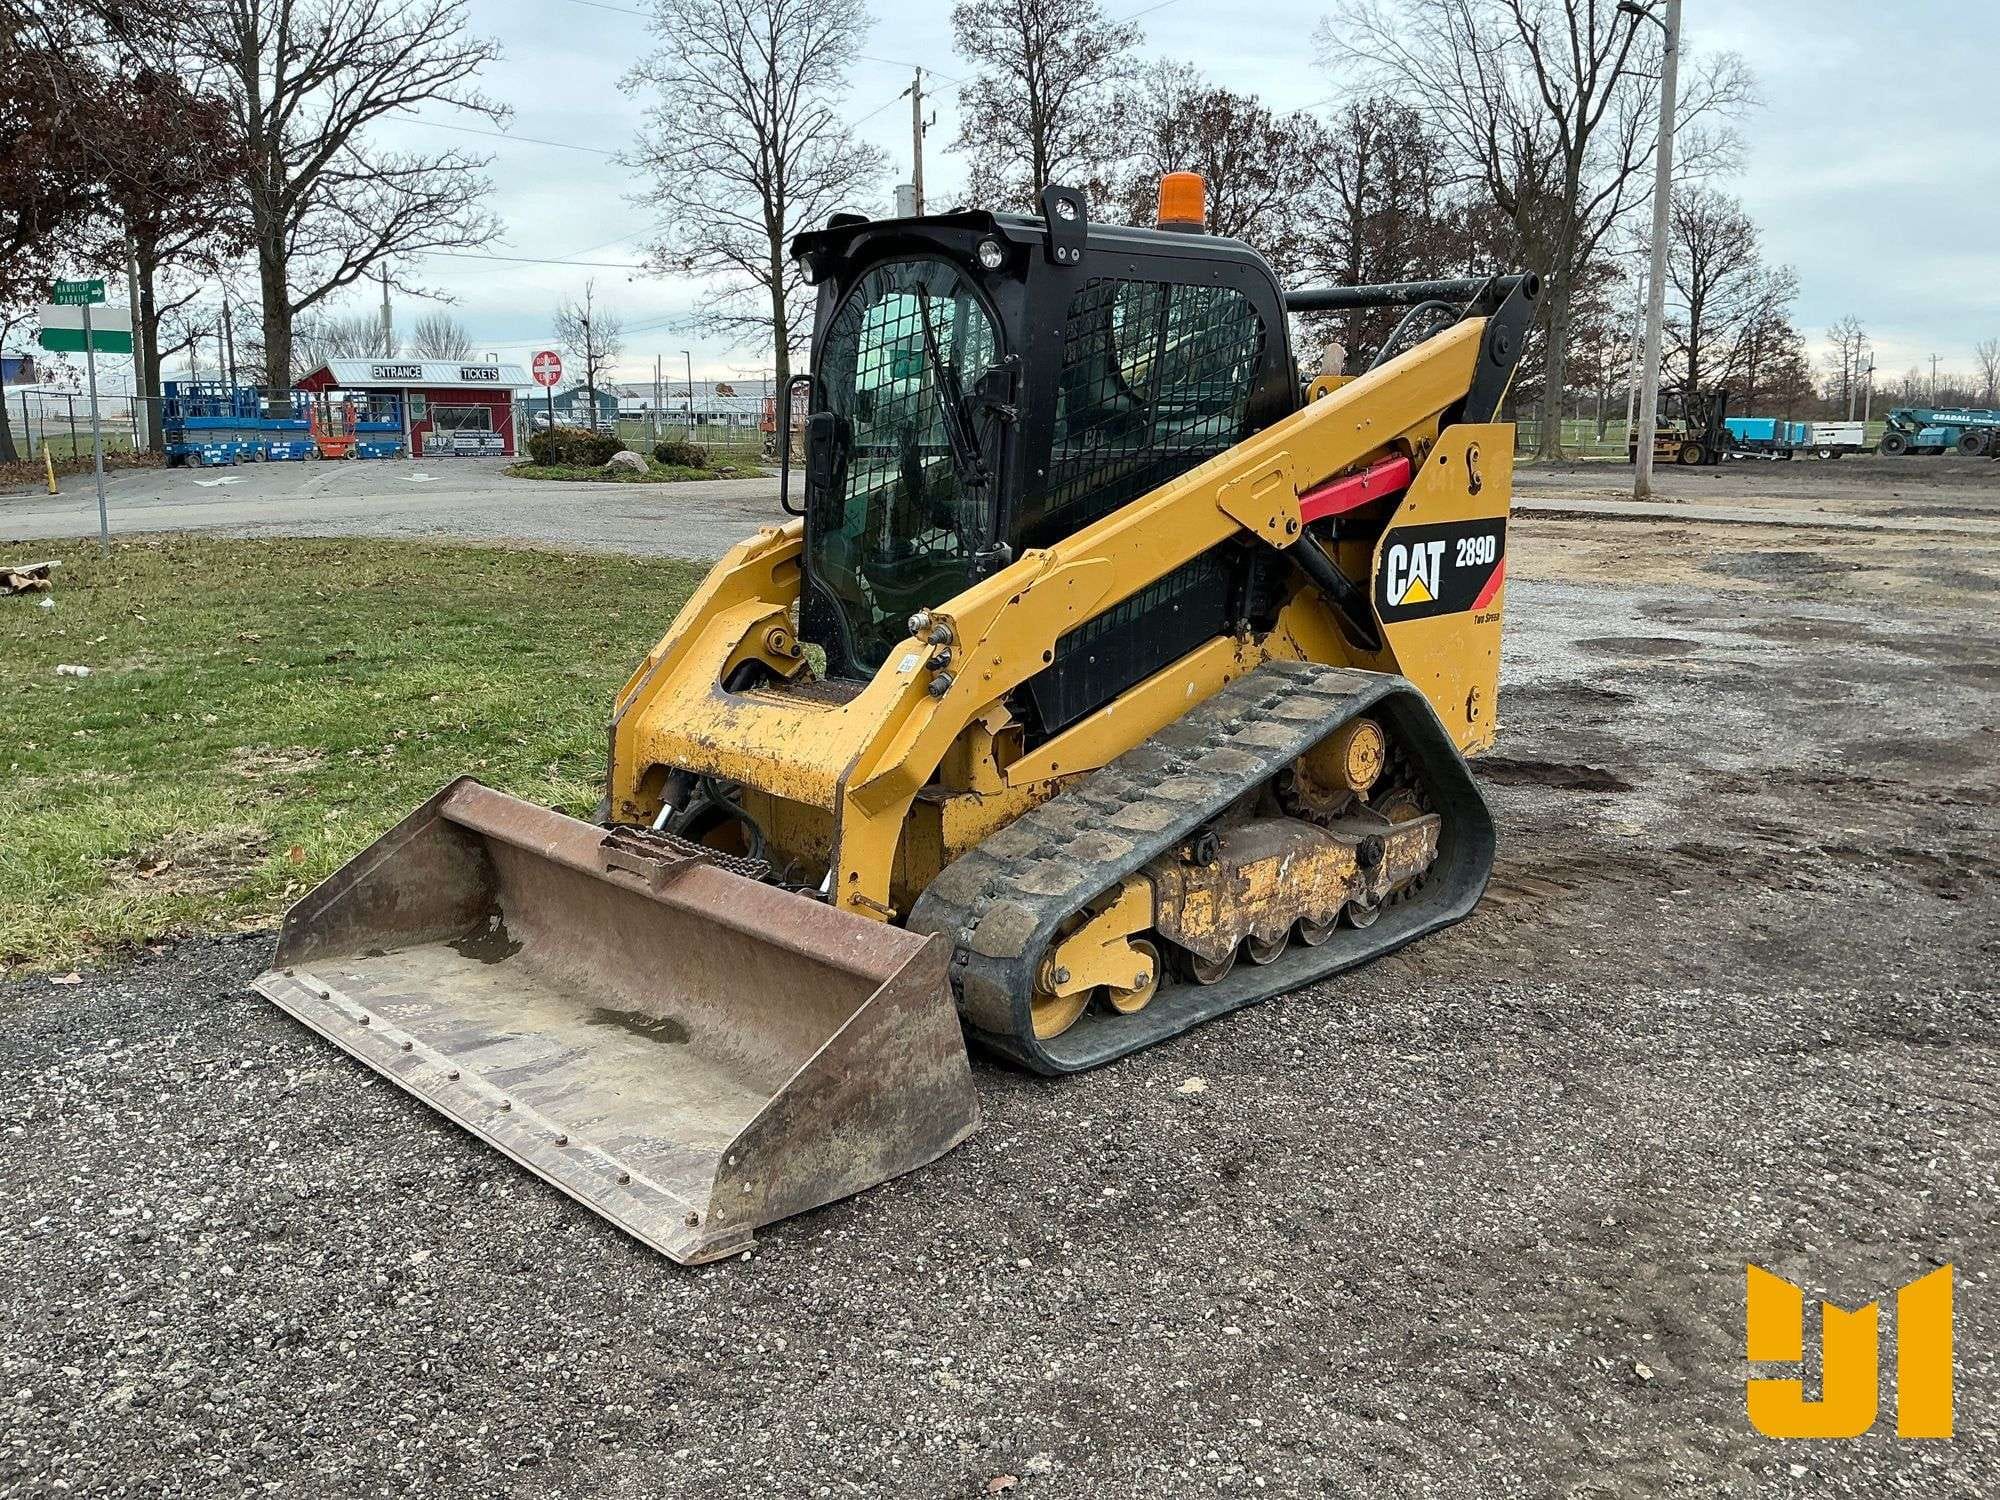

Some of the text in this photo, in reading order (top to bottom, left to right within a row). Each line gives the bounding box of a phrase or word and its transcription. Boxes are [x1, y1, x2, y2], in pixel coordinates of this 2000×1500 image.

[57, 283, 89, 293] HANDICAP
[60, 294, 88, 304] PARKING
[536, 356, 544, 365] DO
[374, 366, 498, 379] ENTRANCE TICKETS
[1932, 413, 1971, 422] GRADALL
[1386, 535, 1496, 607] CAT 289D
